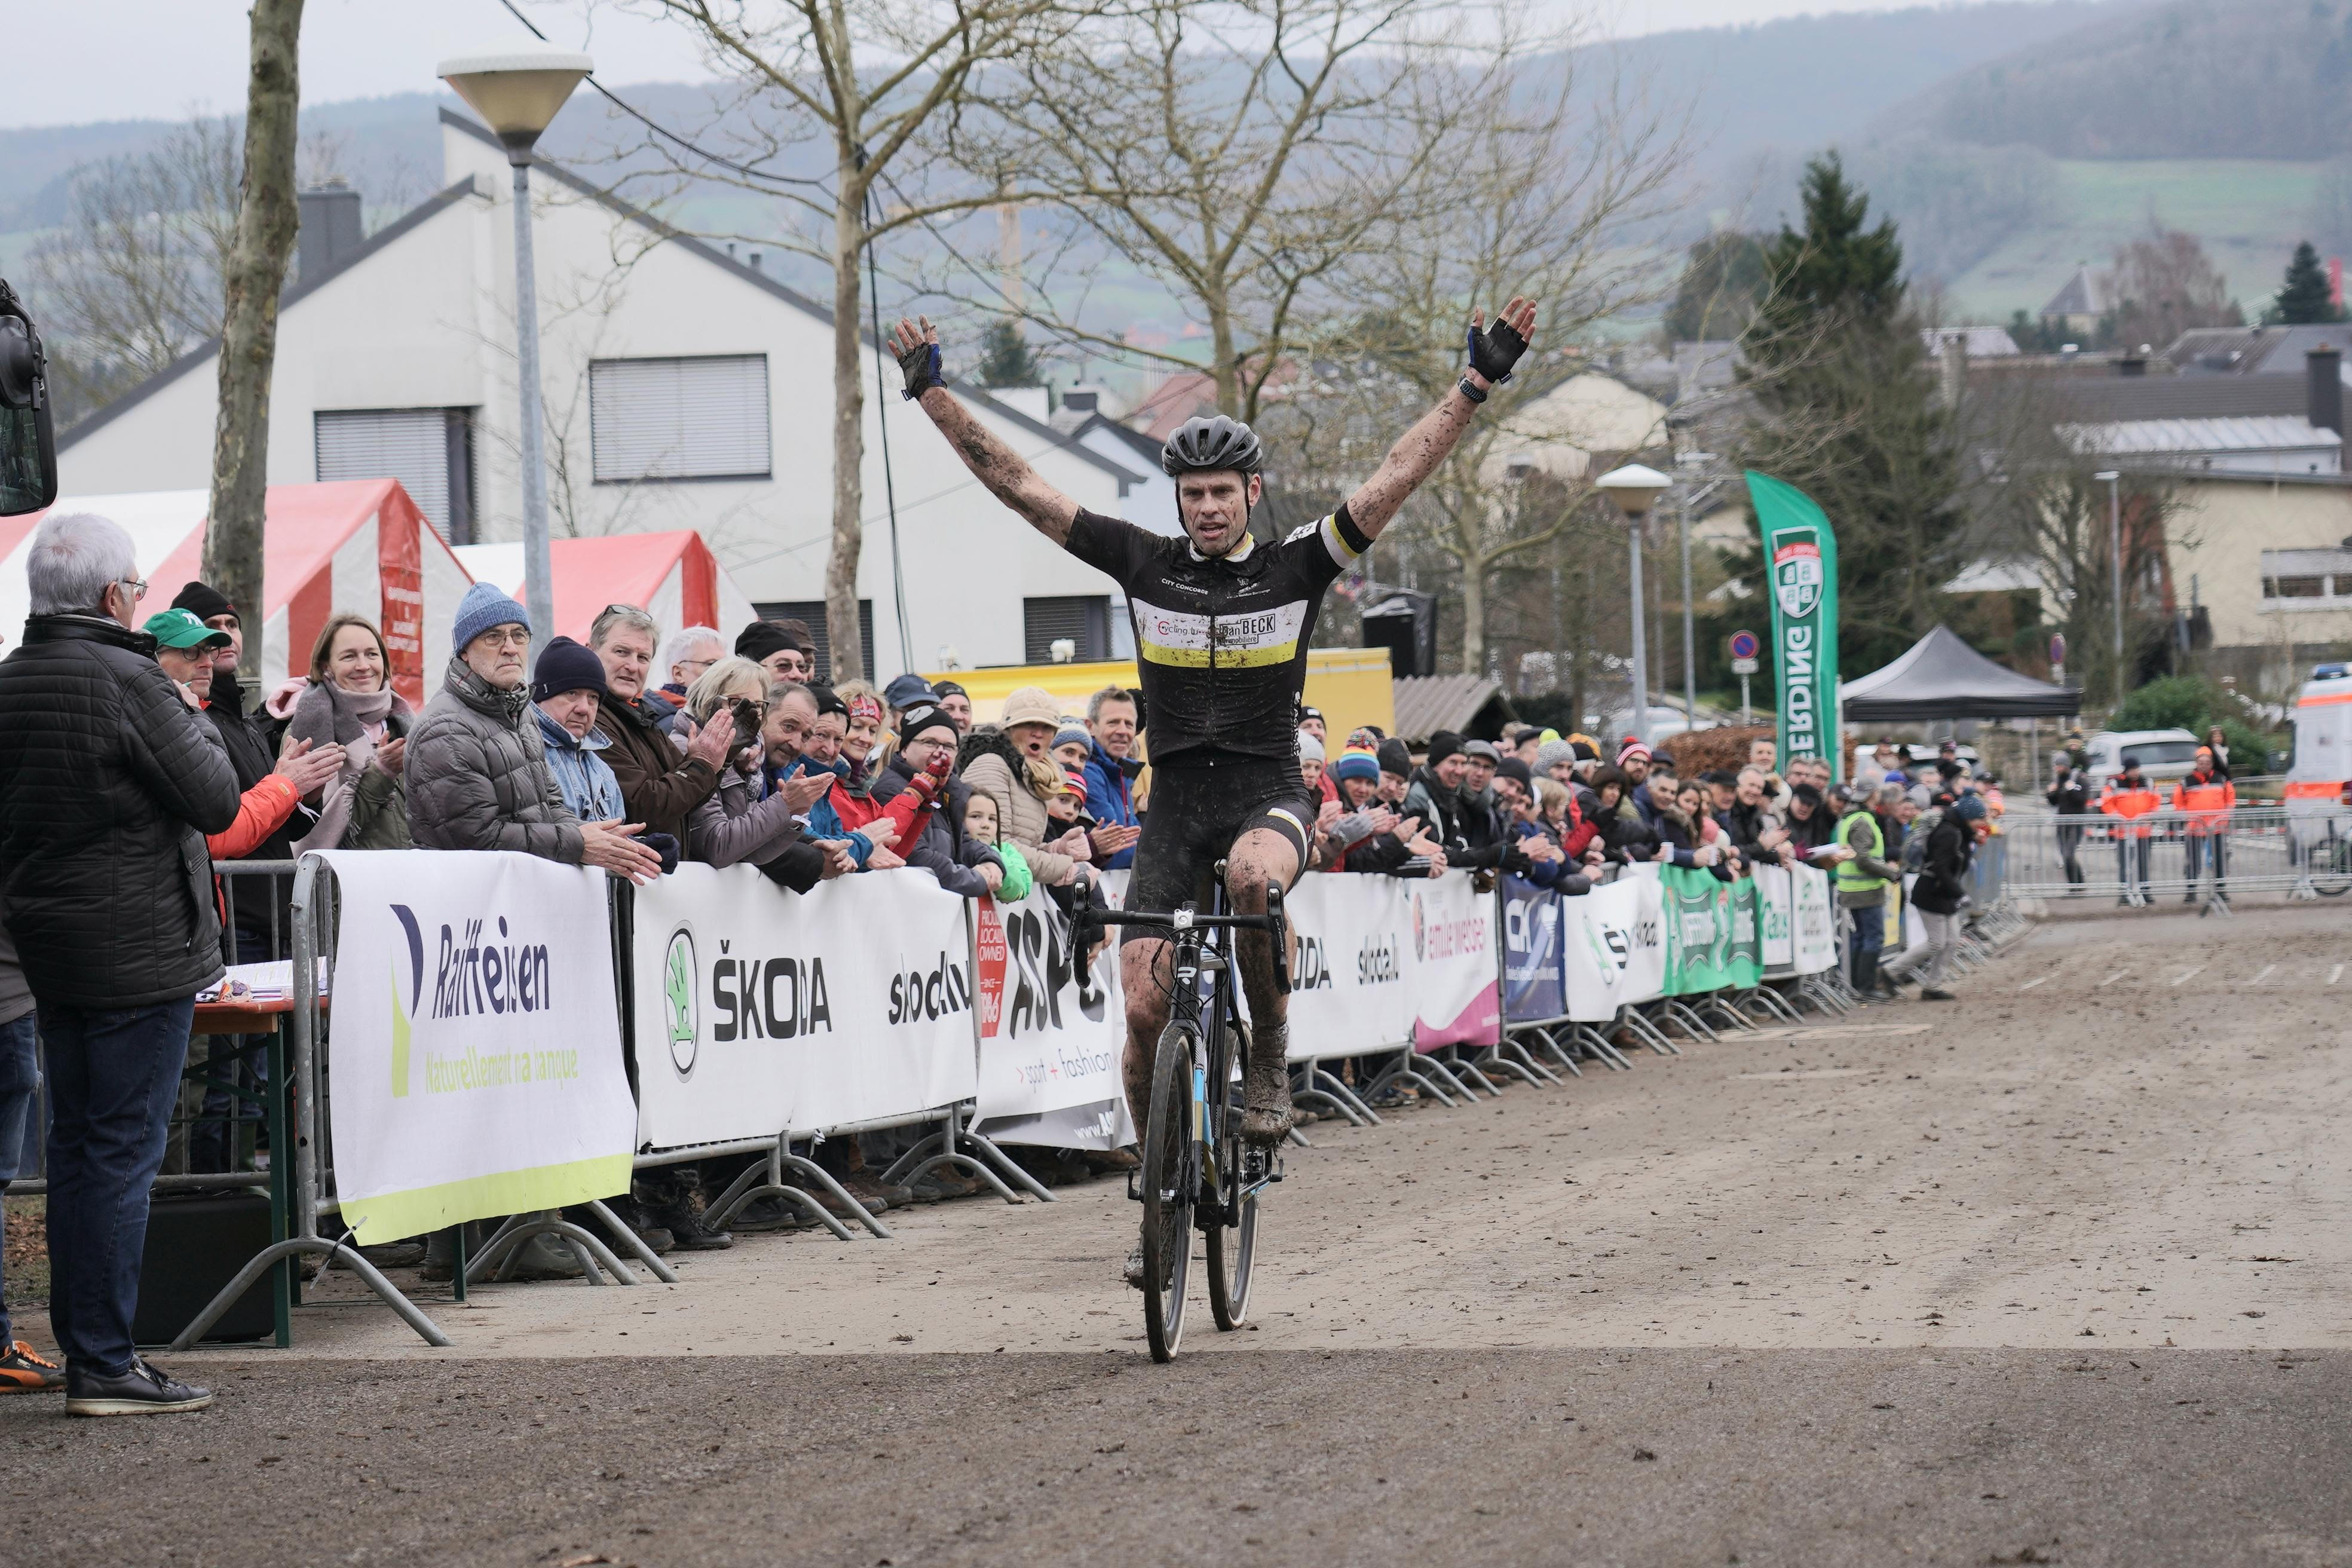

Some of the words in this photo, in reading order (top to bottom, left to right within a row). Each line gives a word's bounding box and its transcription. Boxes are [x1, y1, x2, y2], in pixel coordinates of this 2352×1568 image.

[1161, 578, 1175, 587] CITY
[1175, 583, 1209, 595] CONCORDE
[1159, 621, 1188, 636] Cycling
[1243, 616, 1273, 635] BECK
[425, 1045, 513, 1095] Naturellement
[1058, 1046, 1113, 1078] fashion
